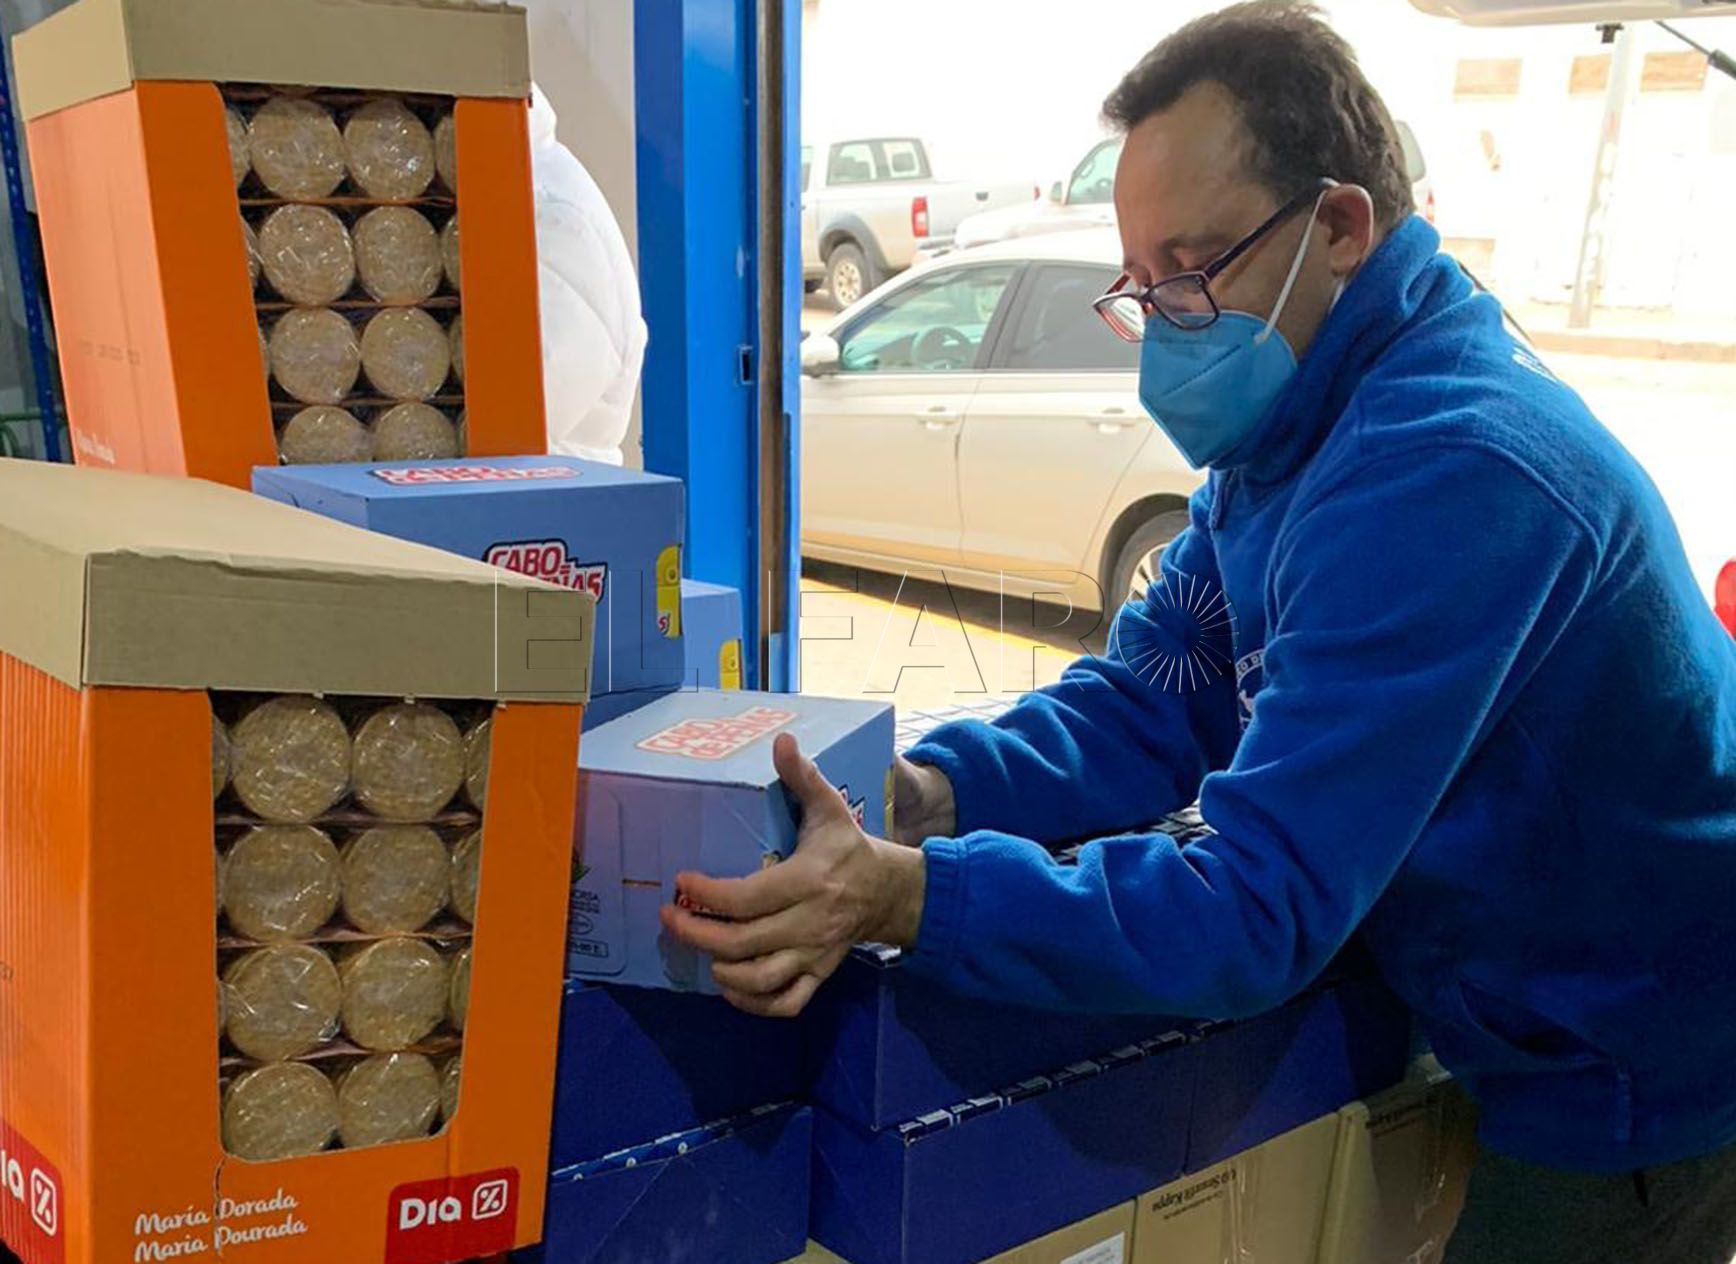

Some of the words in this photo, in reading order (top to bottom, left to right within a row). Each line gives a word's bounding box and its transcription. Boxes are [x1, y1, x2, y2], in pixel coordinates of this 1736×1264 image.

[0, 1149, 24, 1202] IA
[134, 1204, 211, 1236] María
[218, 1187, 299, 1220] Dorada
[134, 1234, 209, 1263] Maria
